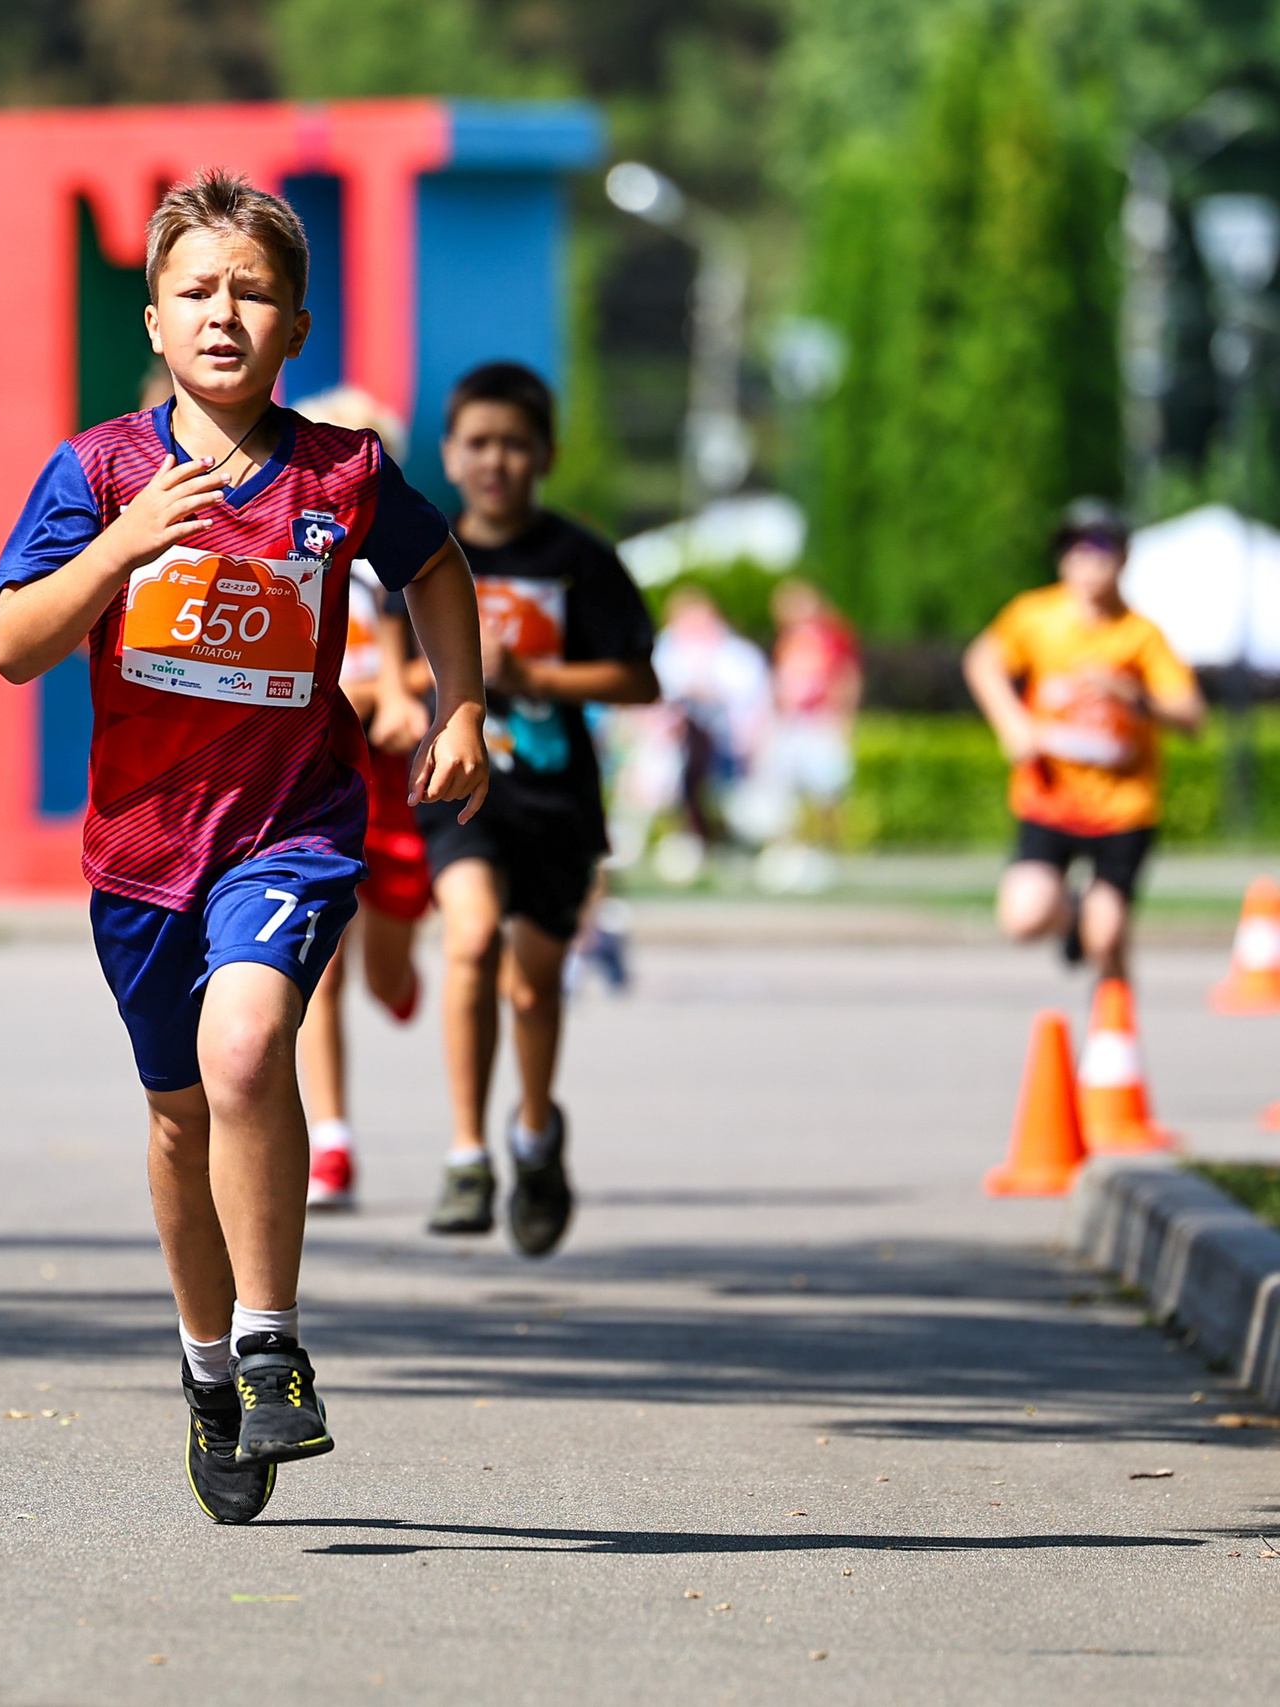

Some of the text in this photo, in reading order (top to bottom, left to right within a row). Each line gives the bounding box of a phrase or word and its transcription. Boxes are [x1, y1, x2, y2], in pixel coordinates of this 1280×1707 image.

[220, 582, 257, 592] 22-23.08
[265, 587, 283, 596] 700
[170, 598, 271, 646] 550
[190, 644, 242, 660] ПЛАТОН
[151, 660, 185, 676] тайга
[268, 687, 291, 697] 89.2 FM
